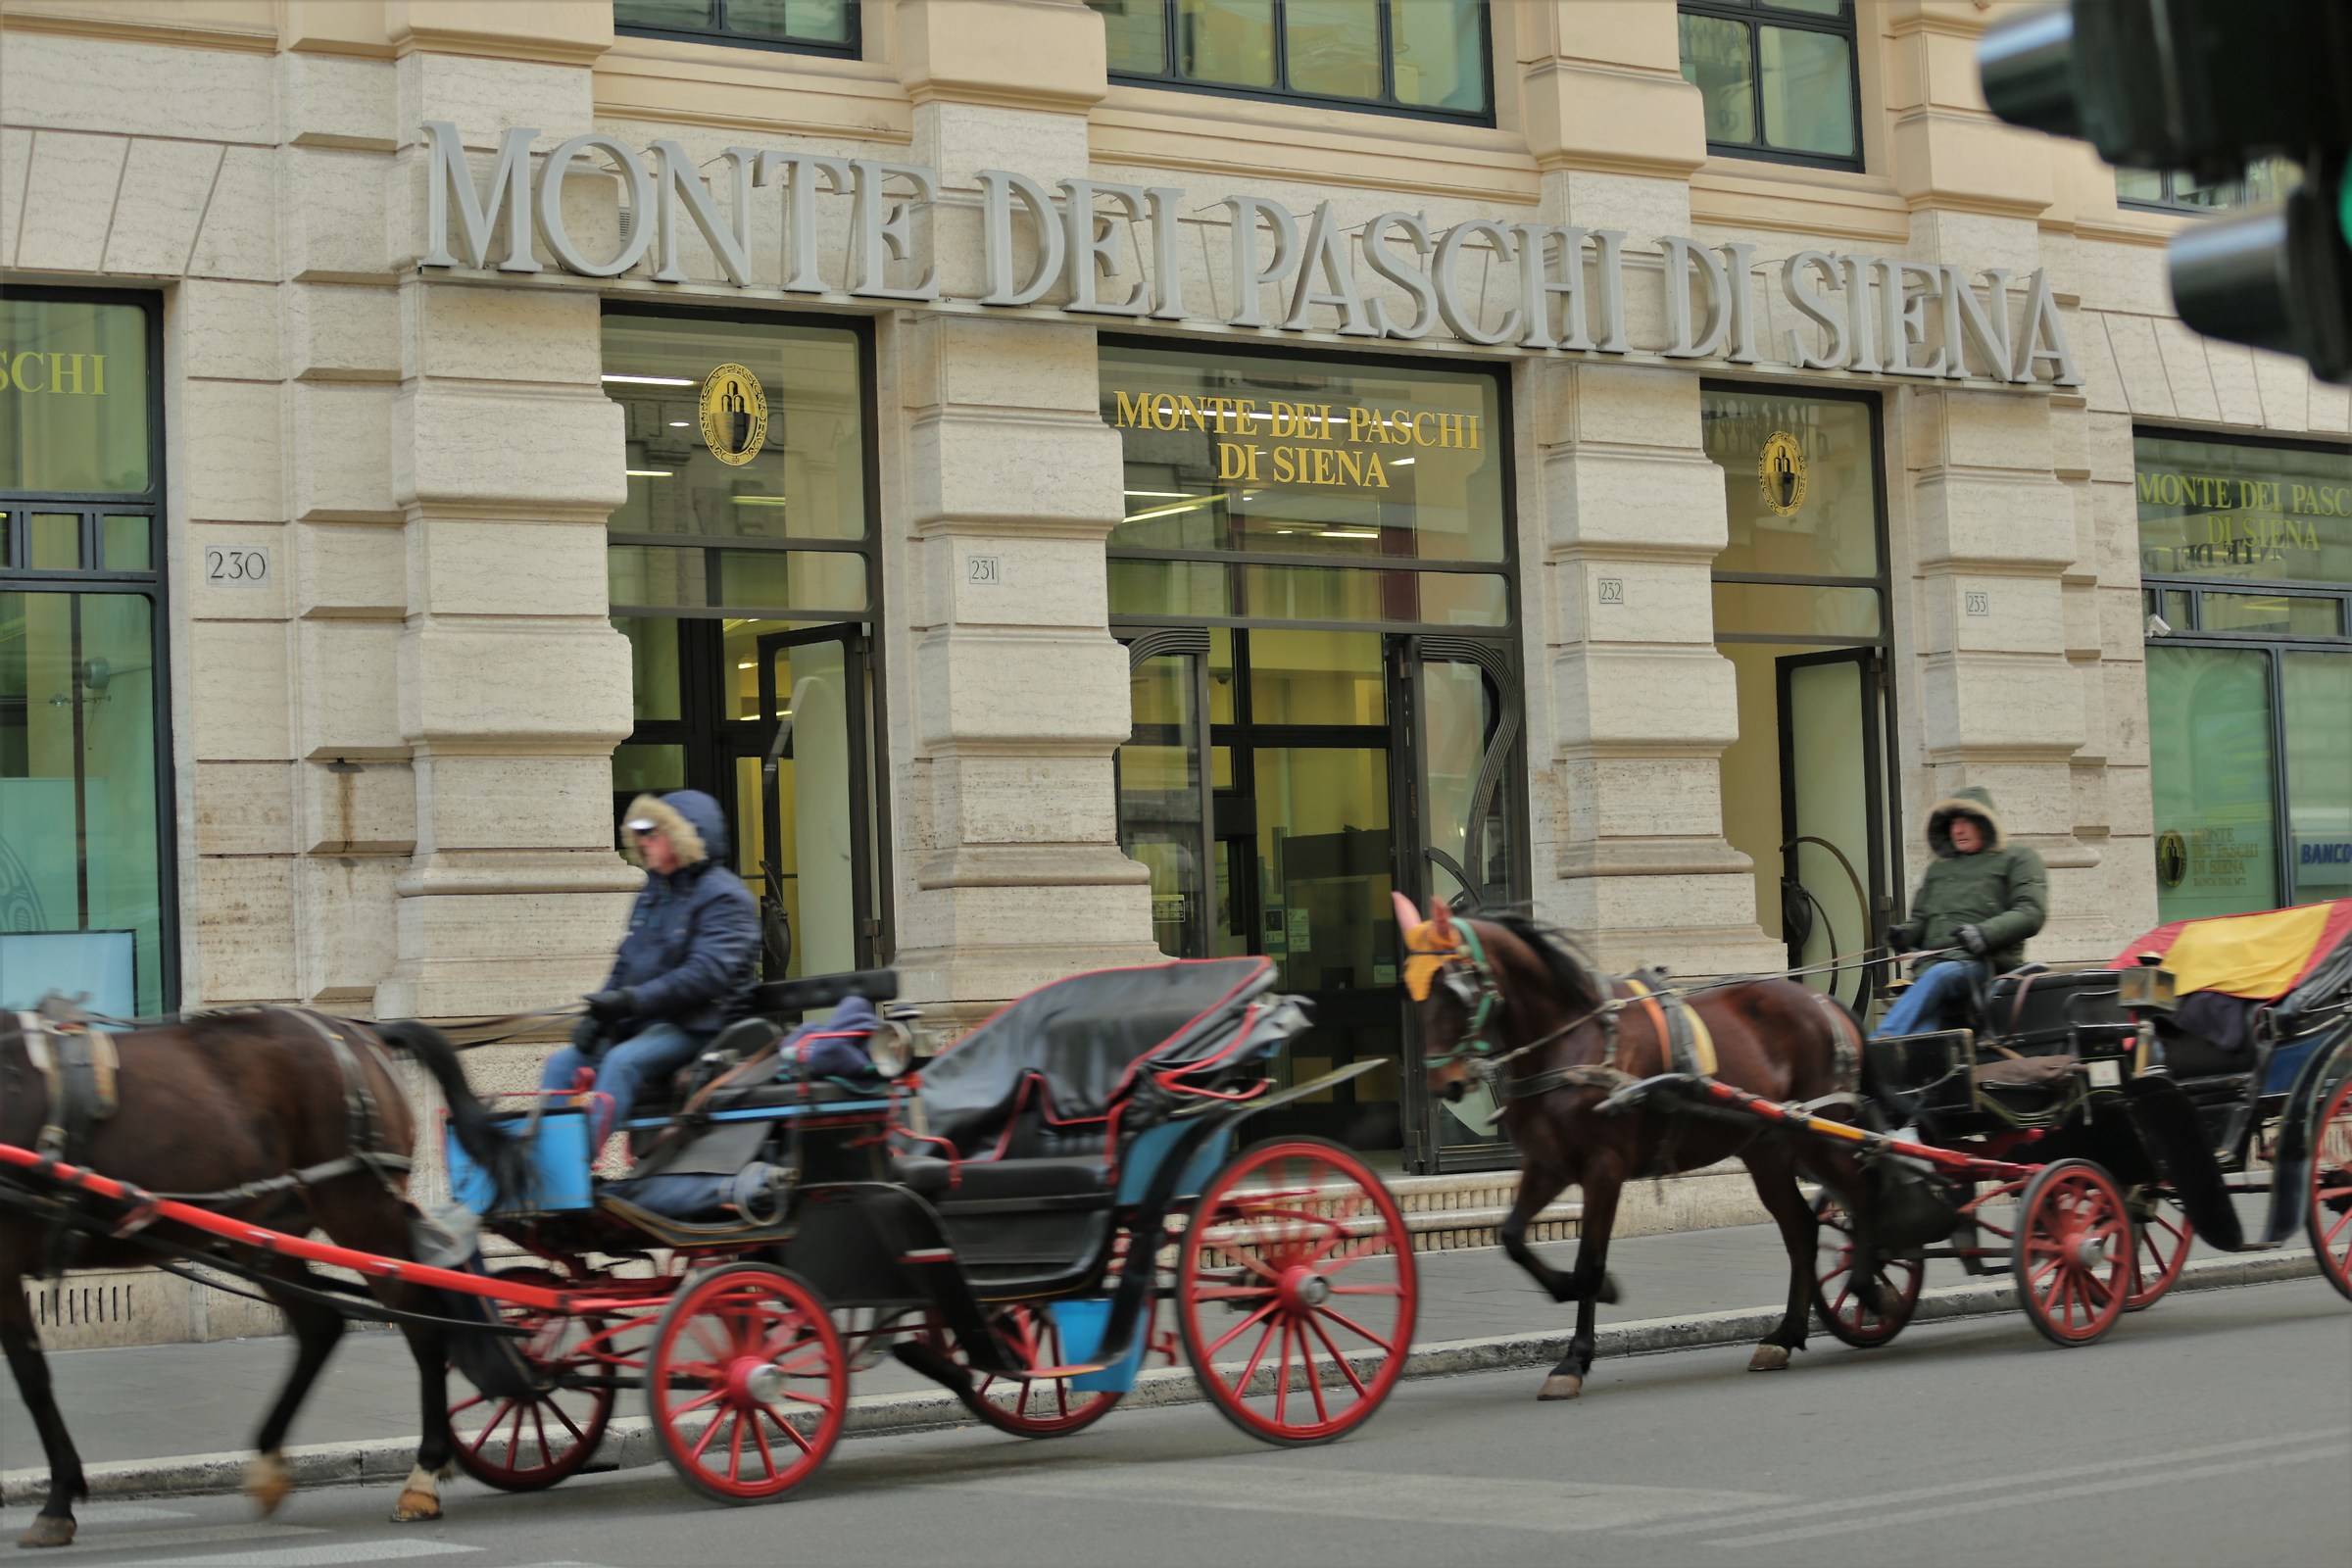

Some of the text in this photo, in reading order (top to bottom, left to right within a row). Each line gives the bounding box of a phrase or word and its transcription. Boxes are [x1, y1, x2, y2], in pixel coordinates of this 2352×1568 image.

[419, 120, 2085, 387] MONTE DEI PASCHI DI SIENA
[1114, 391, 1481, 450] MONTE DEI PASCHI
[1217, 442, 1390, 488] DI SIENA
[2136, 471, 2231, 510] MONTE
[2238, 480, 2282, 513] DEI
[2207, 514, 2321, 552] DI SIENA
[209, 551, 266, 580] 230
[971, 560, 995, 580] 231
[1600, 581, 1621, 601] 232
[1968, 595, 1986, 612] 233
